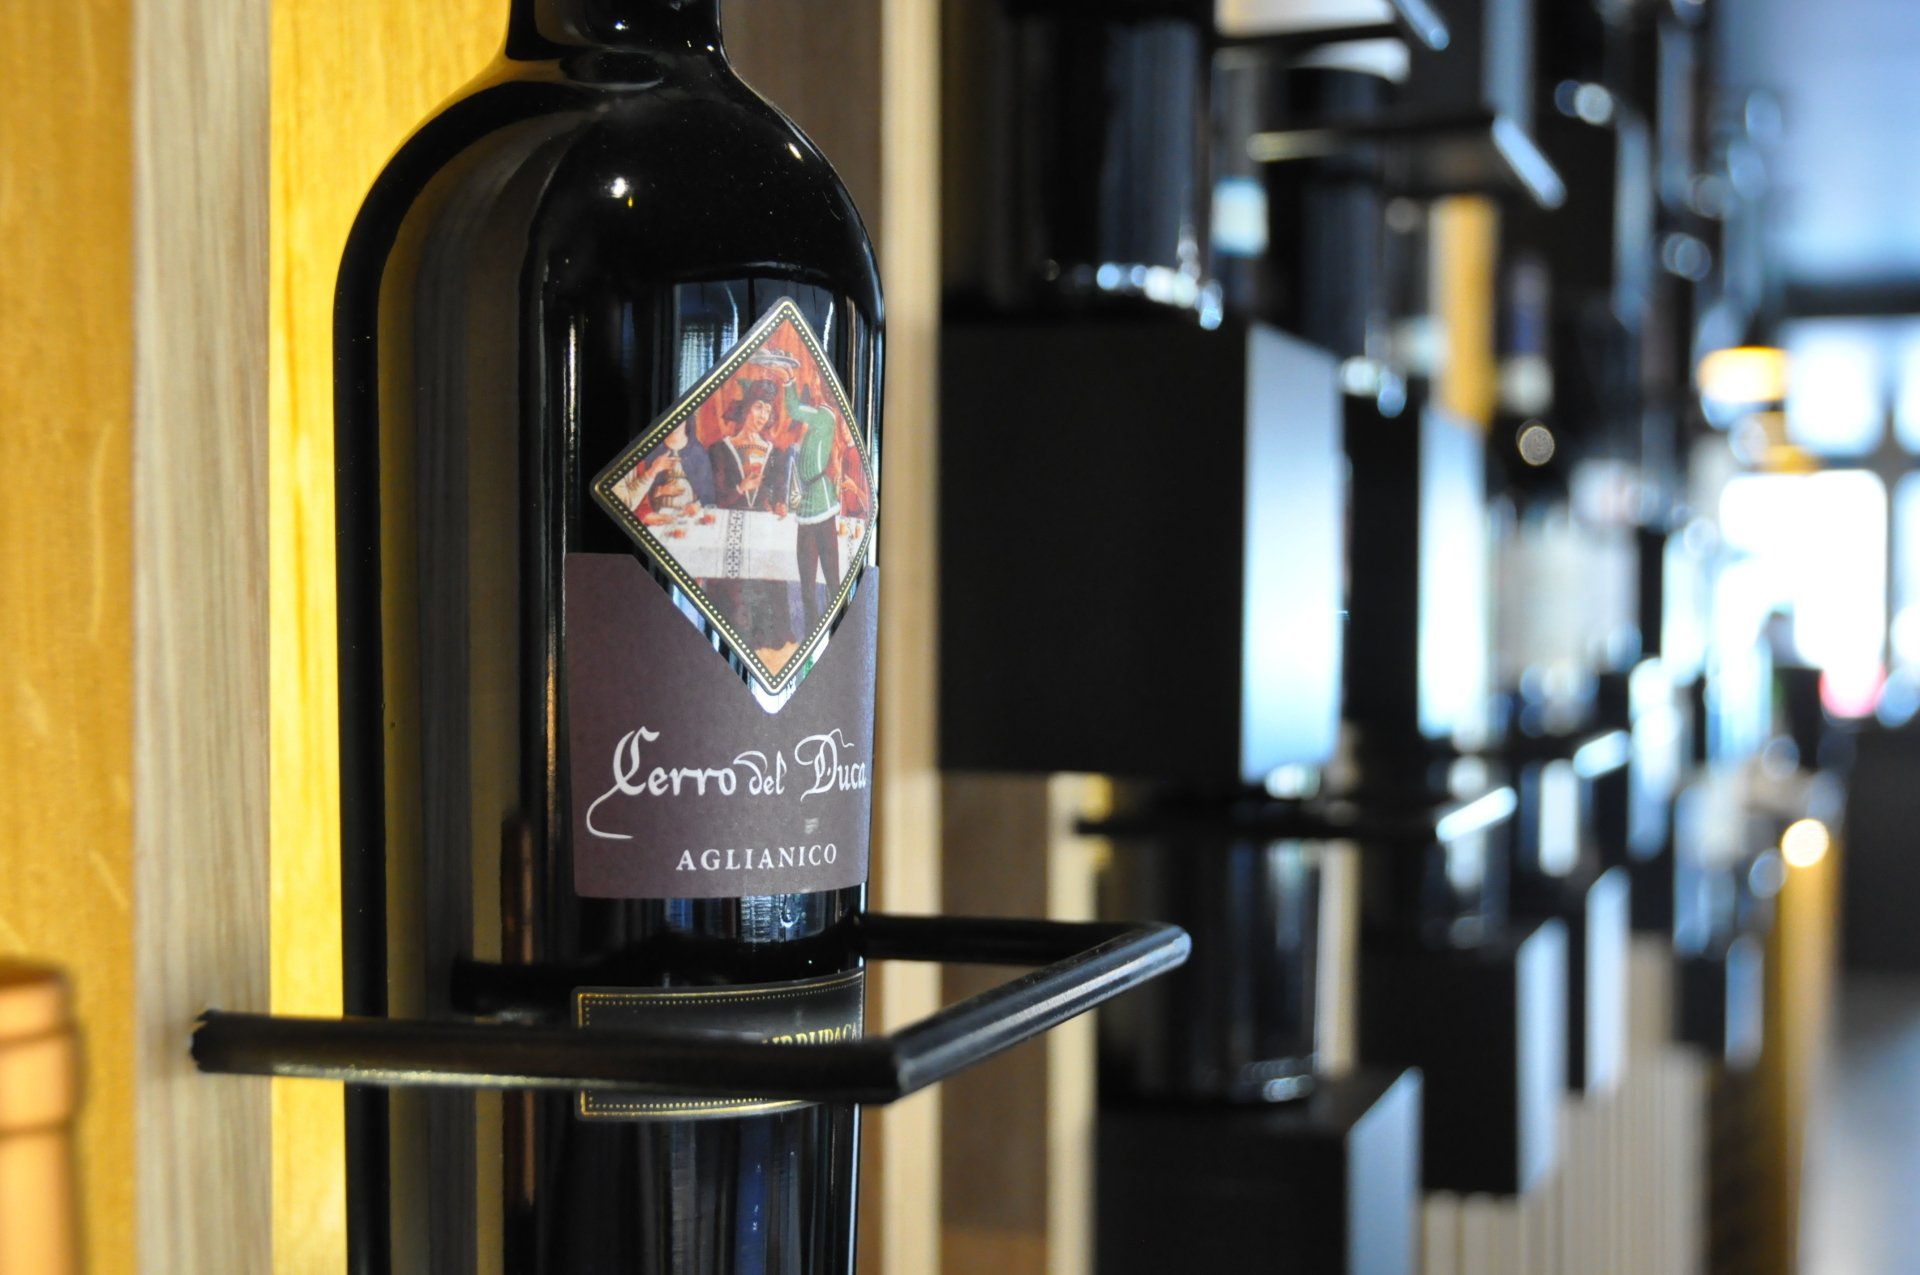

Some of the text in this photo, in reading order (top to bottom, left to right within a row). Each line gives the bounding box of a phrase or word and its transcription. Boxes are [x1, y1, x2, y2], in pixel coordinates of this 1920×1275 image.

[586, 726, 867, 839] Cerro del Duca
[675, 843, 837, 871] AGLIANICO
